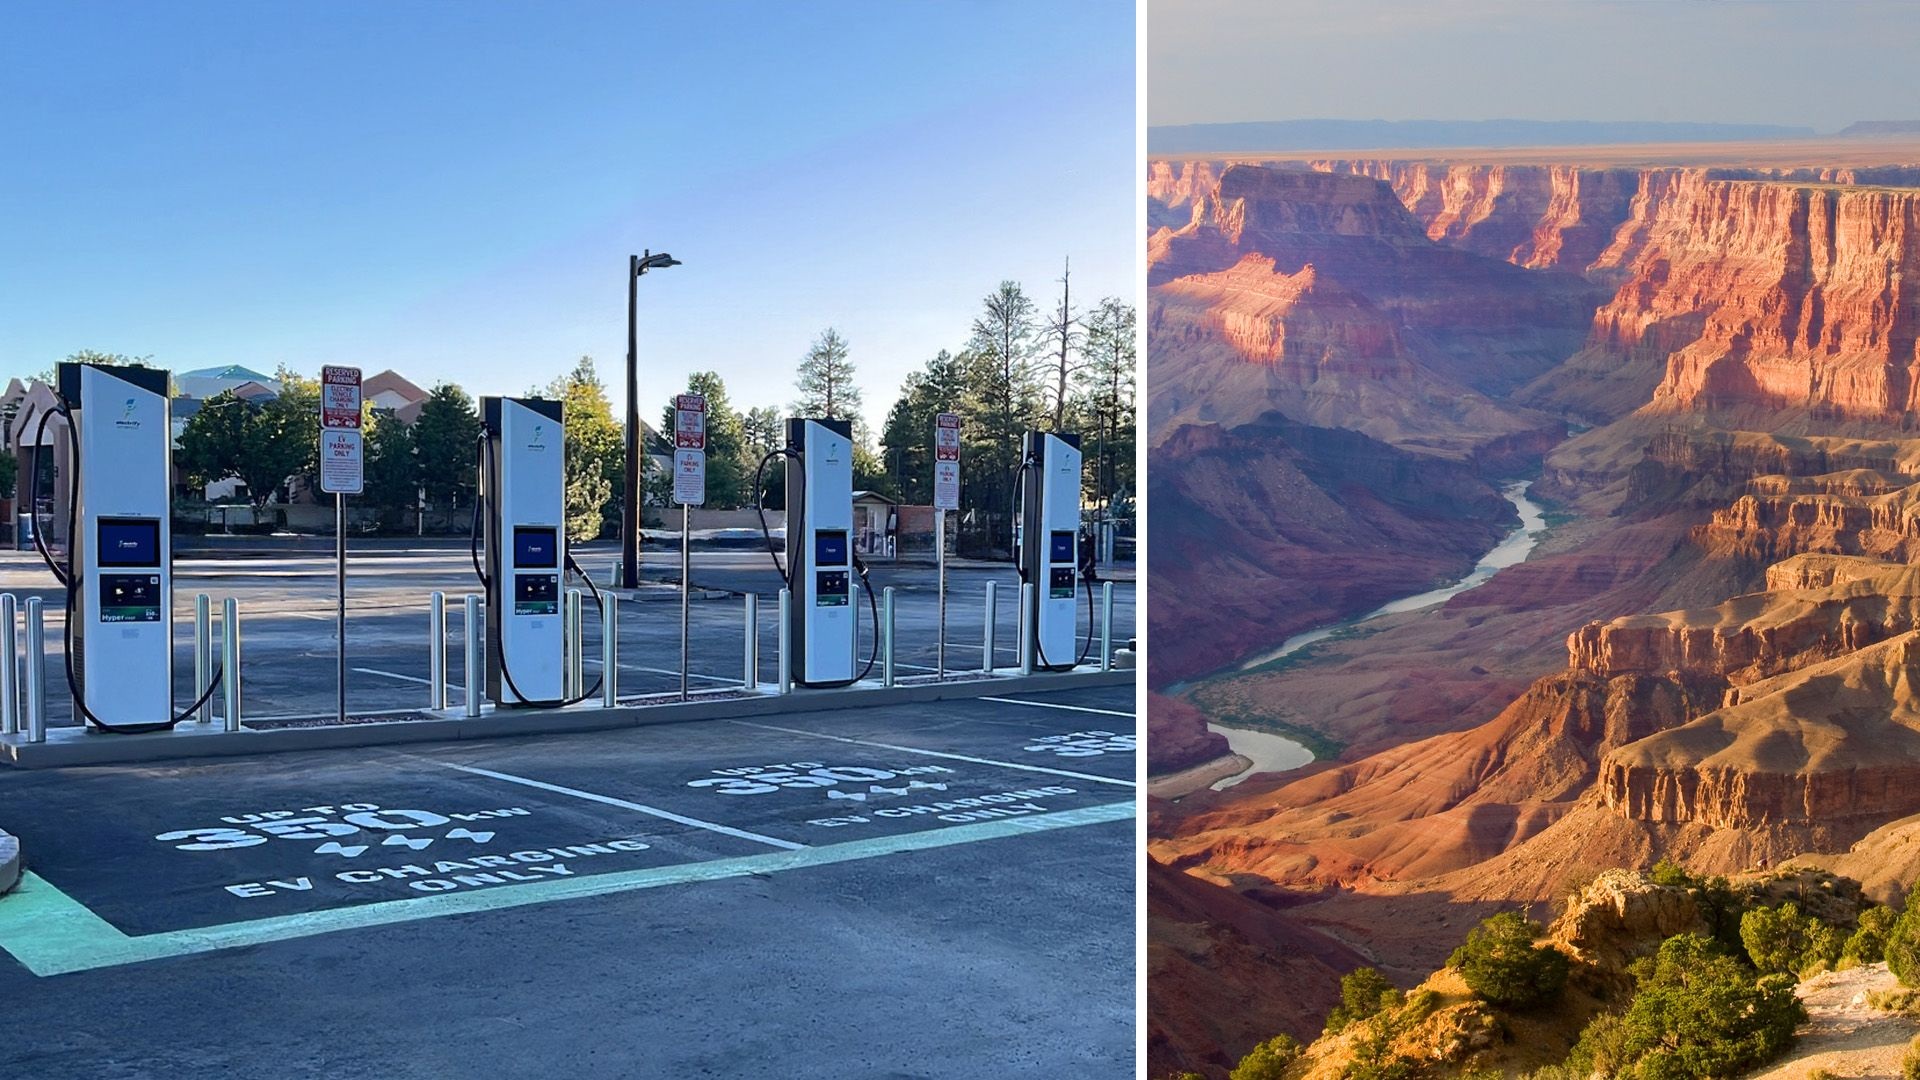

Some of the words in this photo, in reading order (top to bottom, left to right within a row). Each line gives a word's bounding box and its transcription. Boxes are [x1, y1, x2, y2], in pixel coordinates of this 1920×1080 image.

[325, 367, 359, 377] RESERVED
[327, 374, 357, 384] PARKING
[329, 442, 356, 451] PARKING
[334, 449, 351, 457] ONLY
[765, 761, 824, 771] TO
[687, 766, 896, 795] 350
[874, 786, 1077, 818] CHARGING
[937, 802, 1048, 822] ONLY
[220, 811, 295, 824] UP
[302, 803, 379, 814] TO
[155, 809, 450, 850] 350
[224, 877, 312, 897] EV
[335, 840, 650, 883] CHARGING
[409, 863, 574, 891] ONLY
